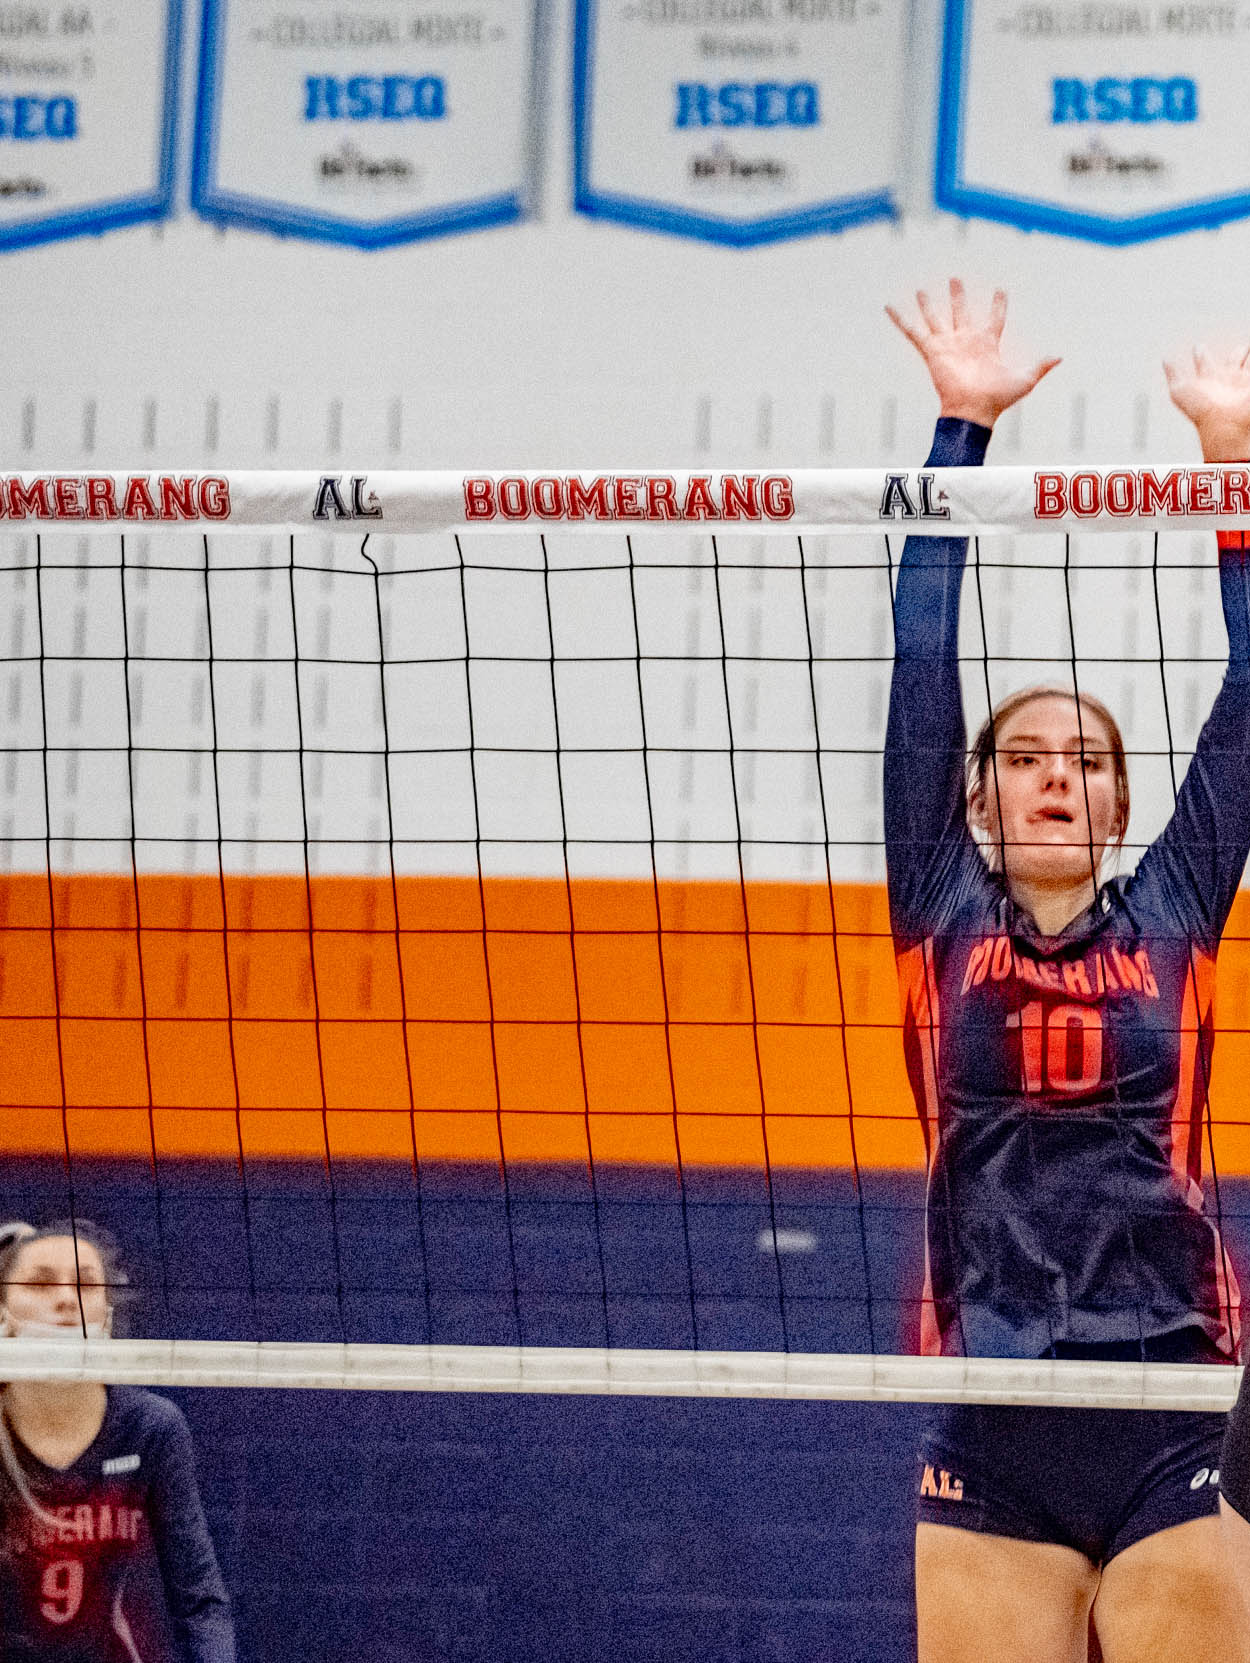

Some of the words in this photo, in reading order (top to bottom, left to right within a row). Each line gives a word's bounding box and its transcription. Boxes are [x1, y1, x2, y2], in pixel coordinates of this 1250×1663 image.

[0, 95, 77, 139] EQ
[304, 73, 447, 121] RSEQ
[674, 80, 821, 129] RSEQ
[1050, 75, 1199, 125] RSEQ
[463, 473, 795, 521] BOOMERANG
[1005, 1001, 1103, 1092] 10
[40, 1559, 85, 1624] 9
